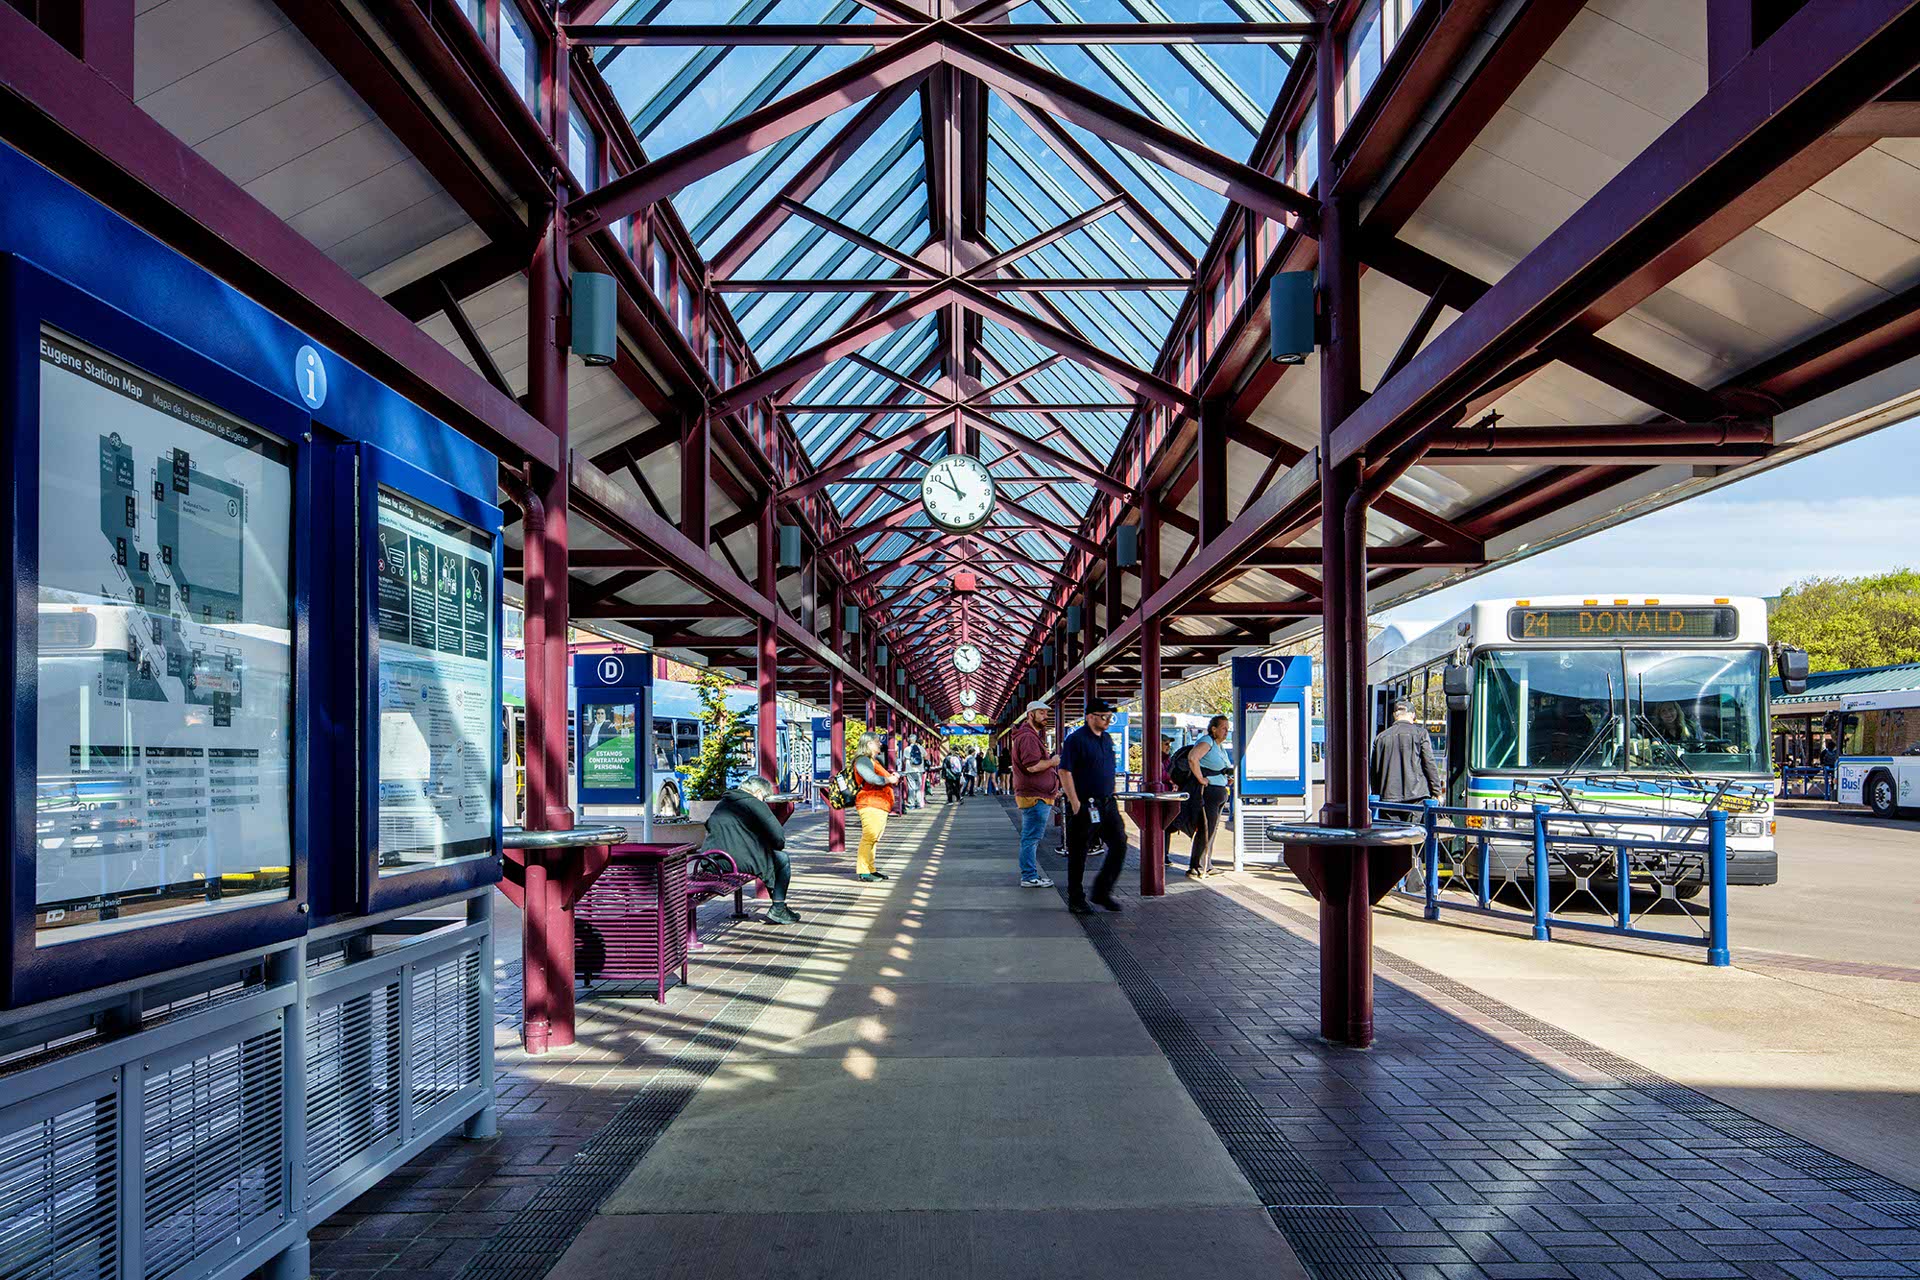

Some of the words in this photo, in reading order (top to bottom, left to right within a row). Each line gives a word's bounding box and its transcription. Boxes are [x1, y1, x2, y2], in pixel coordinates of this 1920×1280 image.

[40, 338, 82, 370] Eugene
[84, 359, 119, 388] Station
[122, 377, 143, 399] Map
[152, 393, 172, 411] Mapa
[172, 403, 182, 415] de
[182, 407, 190, 419] la
[190, 412, 217, 431] estación
[217, 424, 226, 435] de
[225, 427, 249, 445] Eugene
[953, 459, 966, 467] 12
[971, 463, 977, 471] 1
[939, 464, 950, 472] 11
[929, 474, 942, 482] 10
[979, 474, 987, 482] 2
[925, 486, 933, 495] 9
[983, 488, 991, 496] 3
[929, 500, 937, 509] 8
[978, 502, 986, 510] 4
[940, 512, 948, 520] 7
[953, 515, 961, 524] 6
[968, 512, 976, 521] 5
[1523, 612, 1549, 637] 24
[1579, 611, 1685, 632] DONALD
[605, 661, 618, 679] D
[1266, 663, 1279, 679] L
[1842, 765, 1854, 778] The
[1841, 777, 1861, 790] Bus!
[1482, 798, 1519, 811] 1106
[74, 904, 88, 912] Lane
[87, 901, 105, 909] Transit
[104, 897, 122, 907] District
